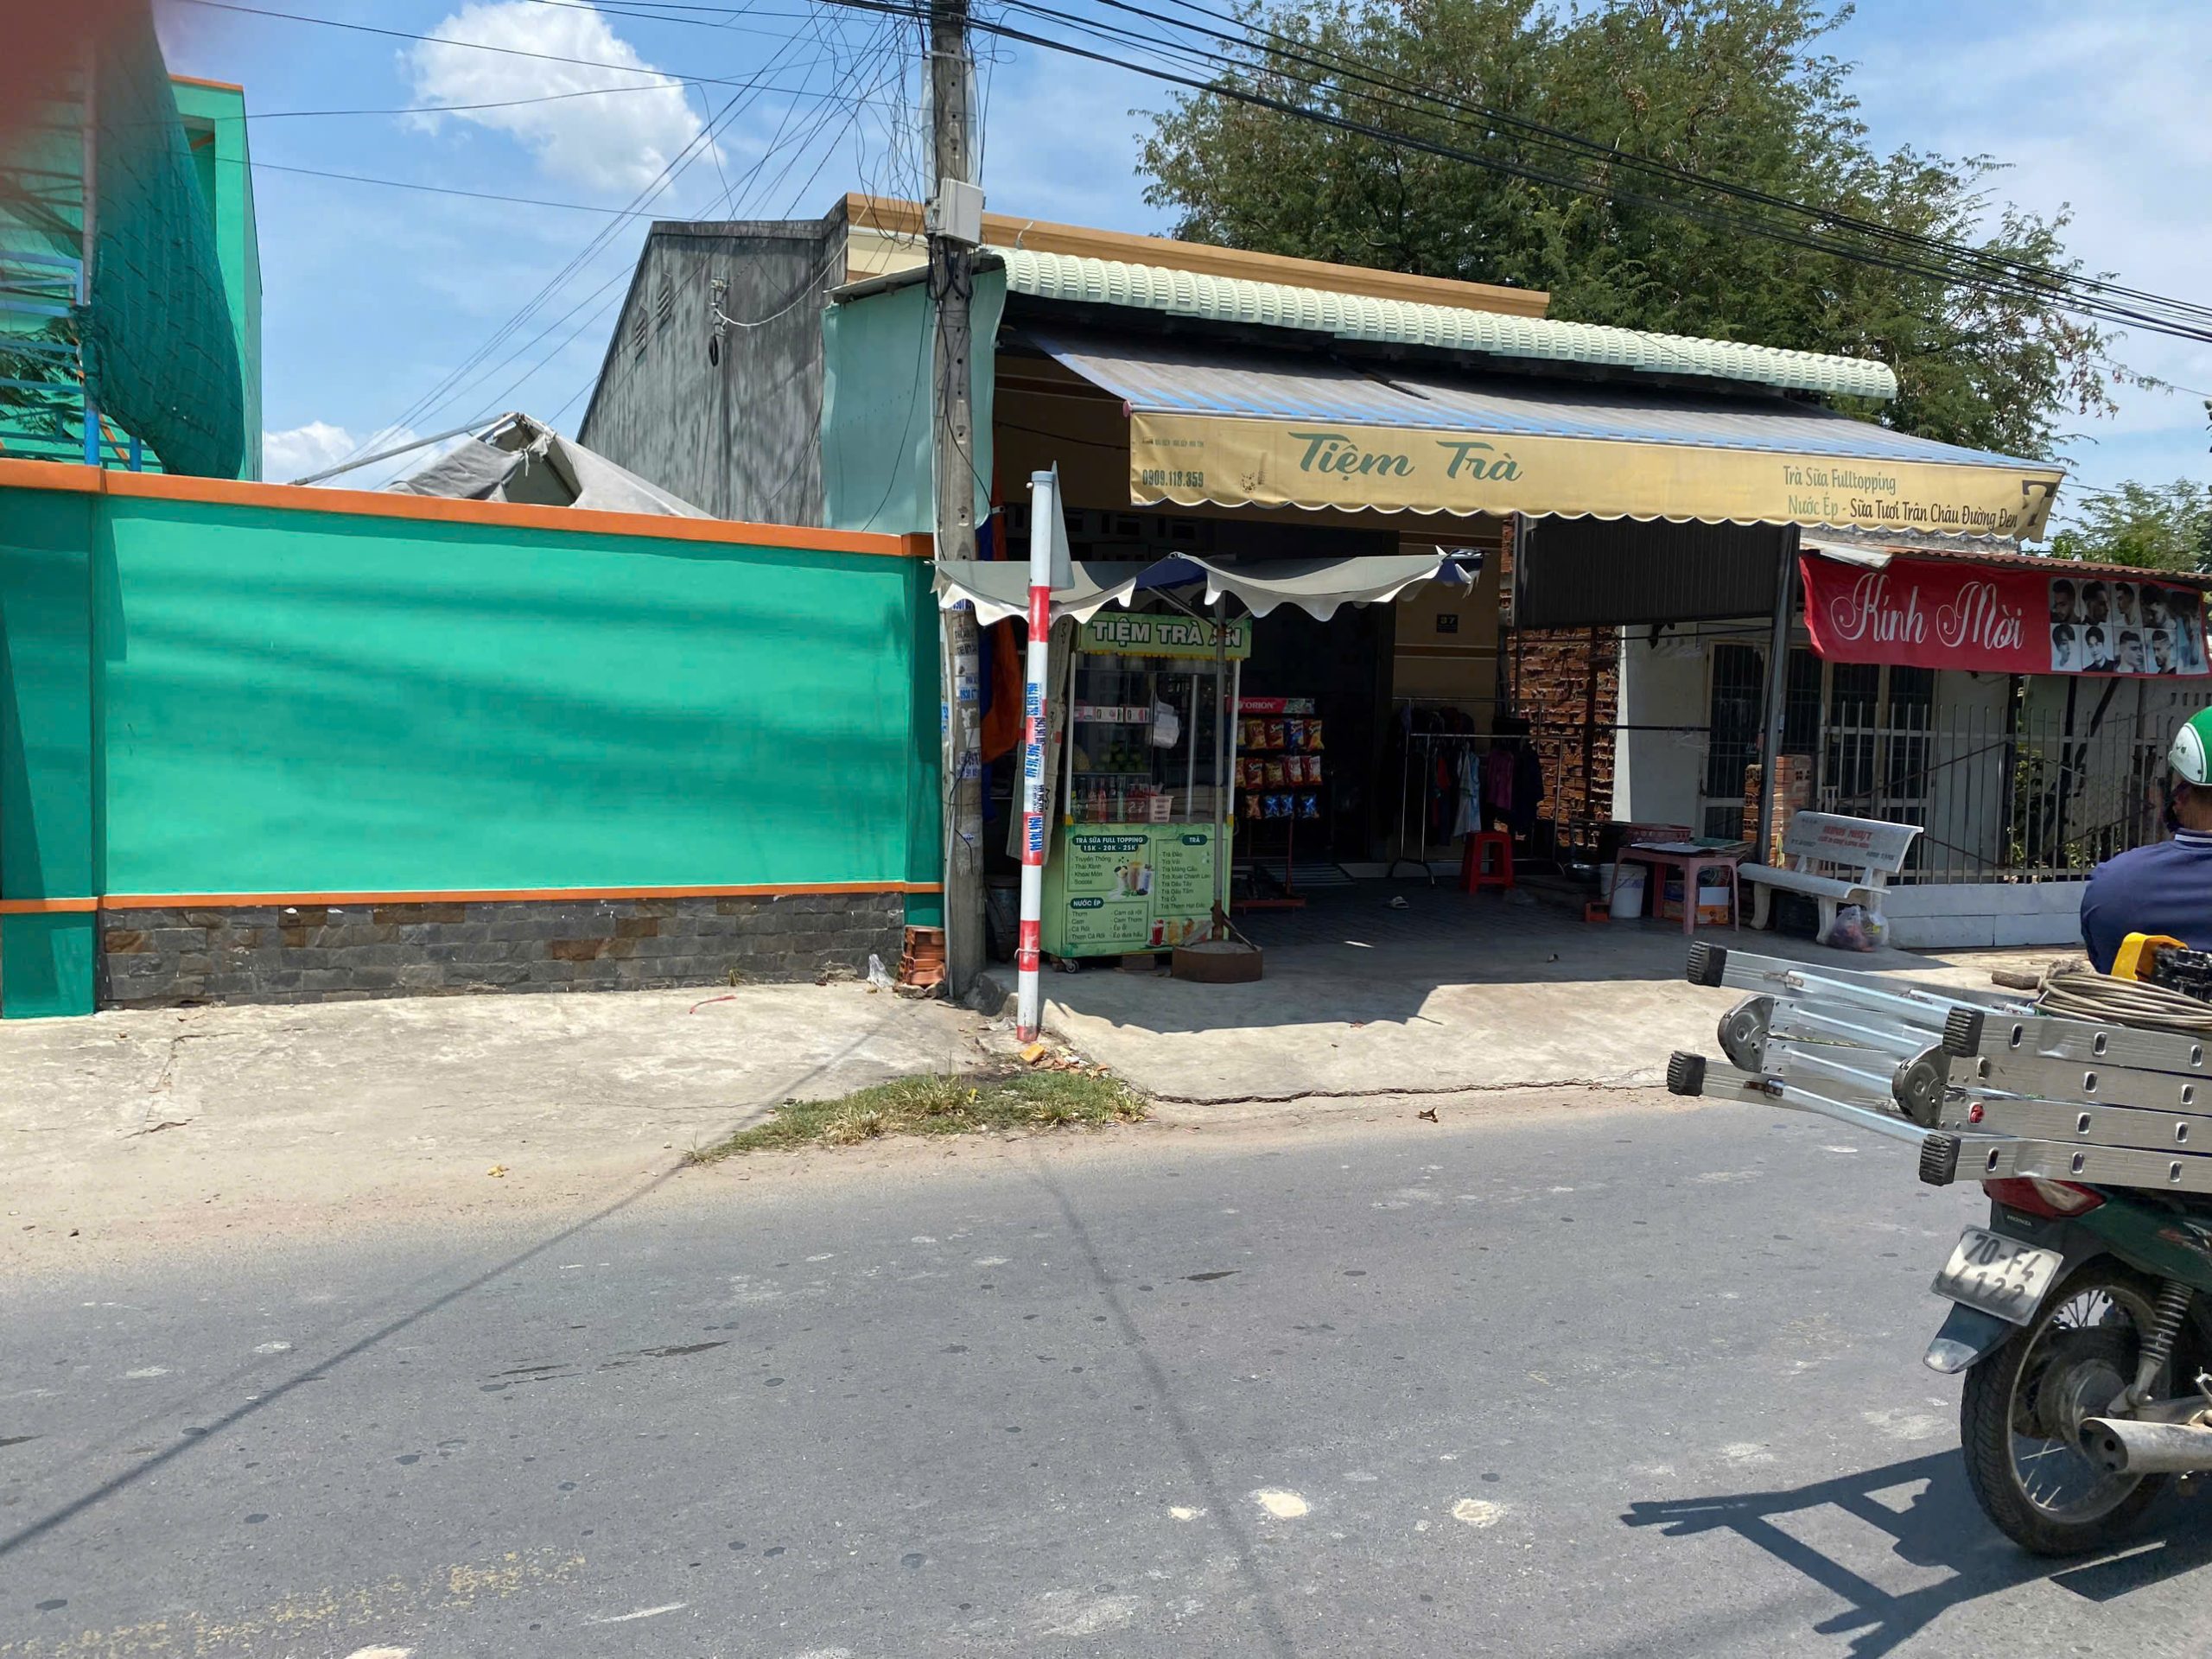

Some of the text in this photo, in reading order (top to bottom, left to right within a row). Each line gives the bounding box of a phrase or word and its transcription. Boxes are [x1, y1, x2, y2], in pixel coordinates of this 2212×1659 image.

[1288, 431, 1522, 481] Tiệm Trà
[1142, 468, 1204, 487] 0909.118.359
[1783, 465, 1896, 495] Trà Sữa Fulltopping
[1788, 495, 1820, 515] Nước
[1823, 492, 1839, 520] Ép
[1850, 498, 1873, 518] Sữa
[1875, 499, 1900, 519] Tươi
[1902, 501, 1928, 522] Trân
[1930, 503, 1959, 524] Châu
[1961, 505, 1997, 531] Đường
[1999, 508, 2018, 529] Đen
[1830, 572, 2024, 649] Kính Mời
[1091, 616, 1152, 647] TIỆM
[1157, 620, 1204, 646] TRÀ
[1245, 701, 1274, 709] ORION
[2006, 1214, 2032, 1227] HONDA
[1964, 1234, 2042, 1281] 70-F4
